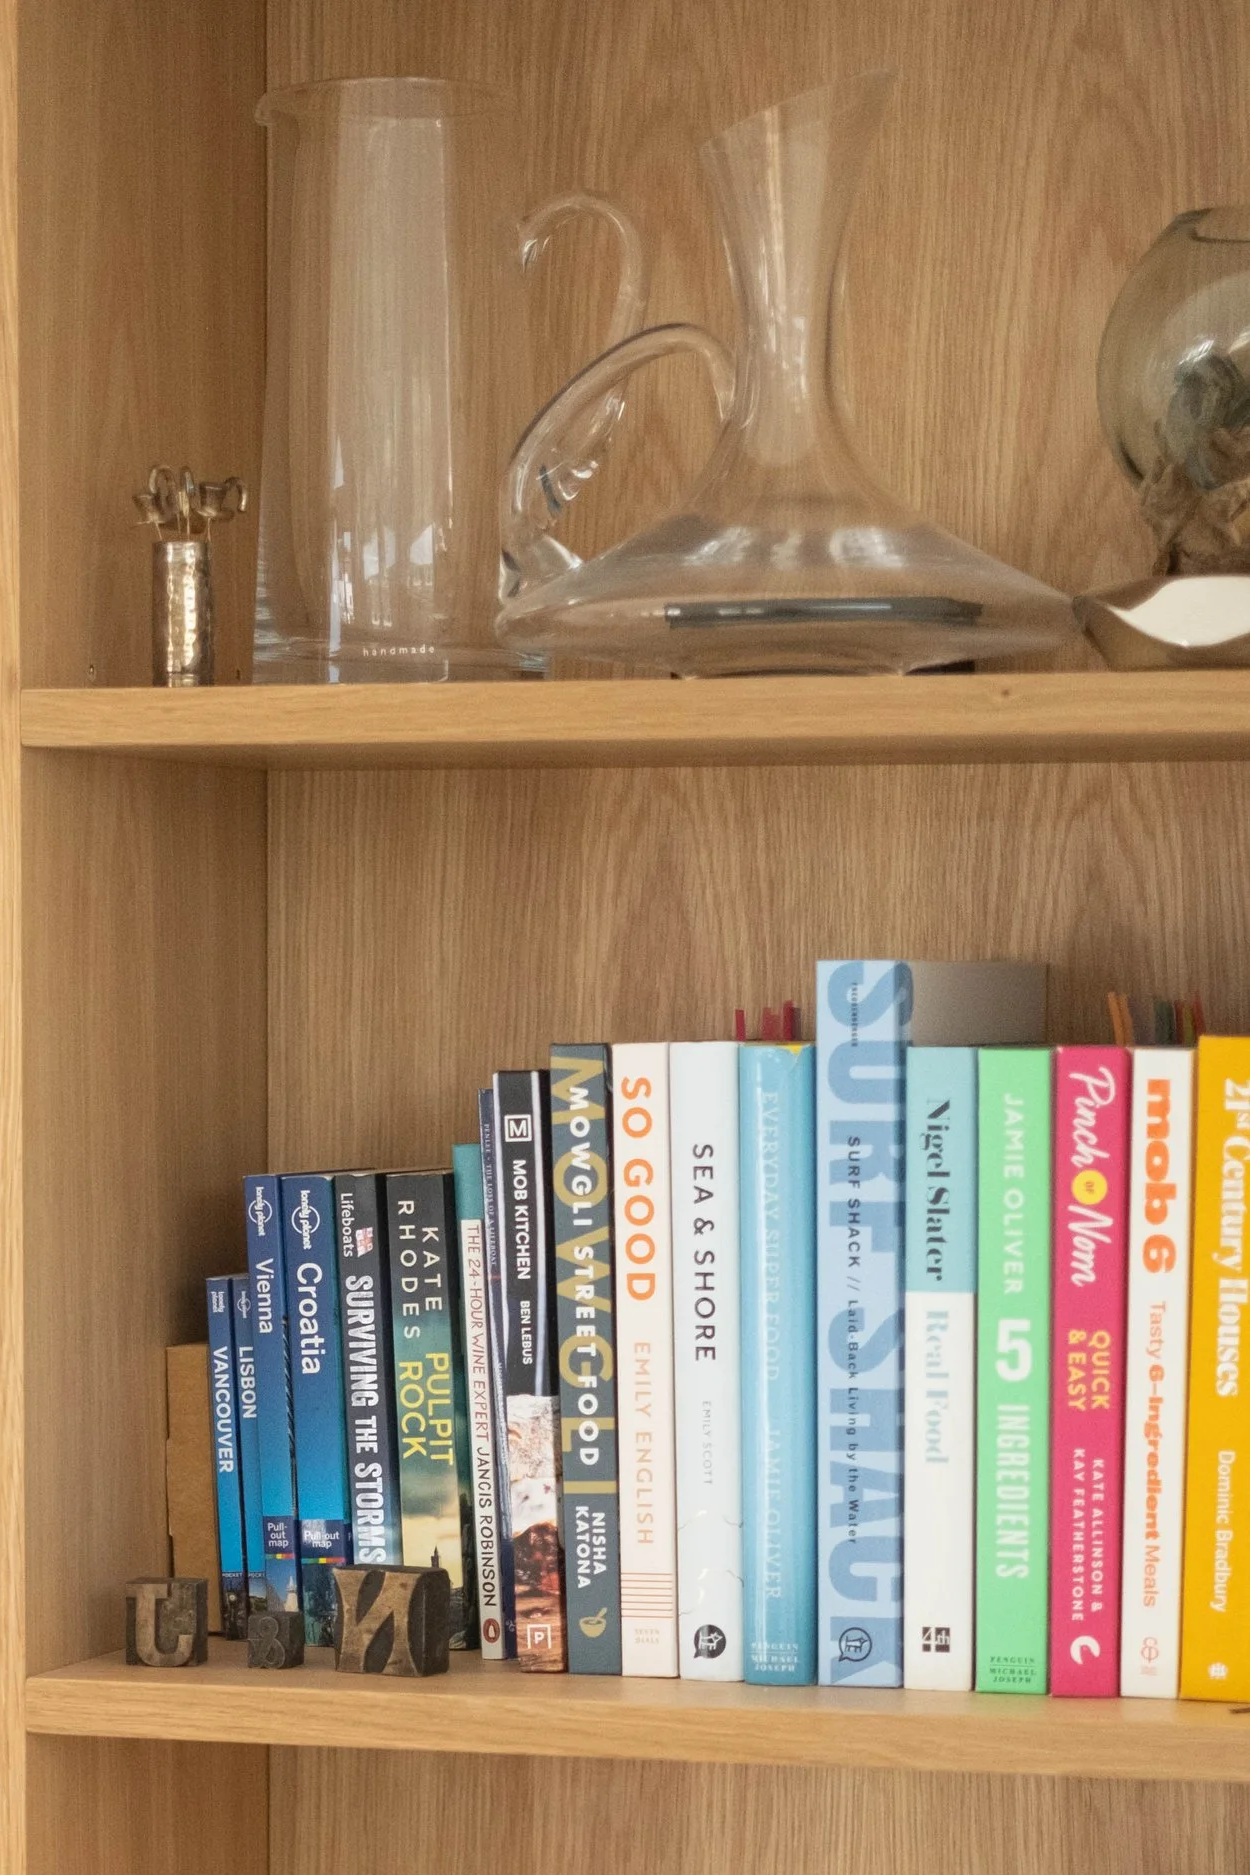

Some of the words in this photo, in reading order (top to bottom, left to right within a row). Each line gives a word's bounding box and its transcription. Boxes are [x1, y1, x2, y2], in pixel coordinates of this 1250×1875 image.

[362, 643, 434, 657] handmade
[509, 1119, 527, 1137] M
[621, 1076, 653, 1139] SO
[920, 1098, 950, 1177] Nigel
[1003, 1094, 1025, 1180] JAMIE
[1068, 1065, 1117, 1168] Pinch
[512, 1159, 528, 1200] MOB
[568, 1086, 593, 1226] MOWGLI
[692, 1143, 714, 1204] SEA
[761, 1091, 779, 1221] EVERYDAY
[847, 1136, 861, 1189] SURF
[1144, 1078, 1177, 1226] mob
[299, 1189, 311, 1219] lonely
[299, 1218, 312, 1250] planet
[340, 1193, 354, 1258] Lifeboats
[623, 1158, 656, 1301] GOOD
[693, 1217, 714, 1235] &
[848, 1198, 861, 1269] SHACK
[926, 1187, 950, 1281] Slater
[1212, 1135, 1250, 1272] Century
[398, 1200, 420, 1339] RHODES
[422, 1226, 443, 1311] KATE
[468, 1225, 481, 1255] THE
[514, 1204, 531, 1280] KITCHEN
[763, 1229, 780, 1304] SUPER
[1003, 1188, 1025, 1295] OLIVER
[1067, 1203, 1114, 1287] Nom
[1142, 1233, 1177, 1274] 6
[255, 1258, 274, 1334] Vienna
[296, 1262, 325, 1374] Croatia
[467, 1258, 484, 1329] 24-HOUR
[520, 1300, 531, 1325] BEN
[573, 1245, 597, 1357] STREET
[693, 1250, 716, 1360] SHORE
[345, 1275, 379, 1407] SURVIVING
[471, 1331, 486, 1375] WINE
[521, 1328, 533, 1365] LEBUS
[764, 1314, 780, 1381] FOOD
[847, 1300, 859, 1380] Laid-Back
[925, 1310, 949, 1379] Real
[994, 1318, 1032, 1382] 5
[1068, 1329, 1087, 1345] &
[1145, 1301, 1167, 1360] Tasty
[1215, 1276, 1250, 1397] Houses
[239, 1346, 257, 1419] LISBON
[633, 1341, 652, 1418] EMILY
[1067, 1353, 1087, 1412] EASY
[1088, 1329, 1111, 1411] QUICK
[213, 1346, 234, 1473] VANCOUVER
[354, 1415, 379, 1454] THE
[398, 1361, 428, 1459] ROCK
[425, 1352, 454, 1465] PULPIT
[473, 1381, 490, 1443] EXPERT
[577, 1375, 600, 1466] FOOD
[702, 1400, 712, 1437] EMILY
[845, 1387, 859, 1436] Living
[925, 1389, 949, 1464] Food
[477, 1447, 493, 1509] JANCIS
[635, 1430, 654, 1545] ENGLISH
[702, 1441, 713, 1485] SCOTT
[765, 1429, 781, 1500] JAMIE
[846, 1443, 859, 1462] by
[848, 1468, 859, 1493] the
[1072, 1448, 1085, 1482] KAY
[1091, 1459, 1104, 1502] KATE
[1216, 1450, 1236, 1525] Dominic
[354, 1462, 387, 1565] STORMS
[847, 1499, 859, 1544] Water
[996, 1404, 1031, 1579] INGREDIENTS
[268, 1539, 289, 1549] map
[270, 1530, 286, 1540] out
[312, 1540, 332, 1550] map
[479, 1515, 496, 1607] ROBINSON
[575, 1506, 591, 1589] KATONA
[592, 1511, 607, 1575] NISHA
[764, 1509, 782, 1600] OLIVER
[1071, 1488, 1086, 1622] FEATHERSTONE
[1091, 1508, 1104, 1596] ALLINSON
[1210, 1528, 1234, 1613] Bradbury
[1091, 1601, 1103, 1613] &
[1143, 1544, 1164, 1608] Meals
[534, 1631, 545, 1645] P
